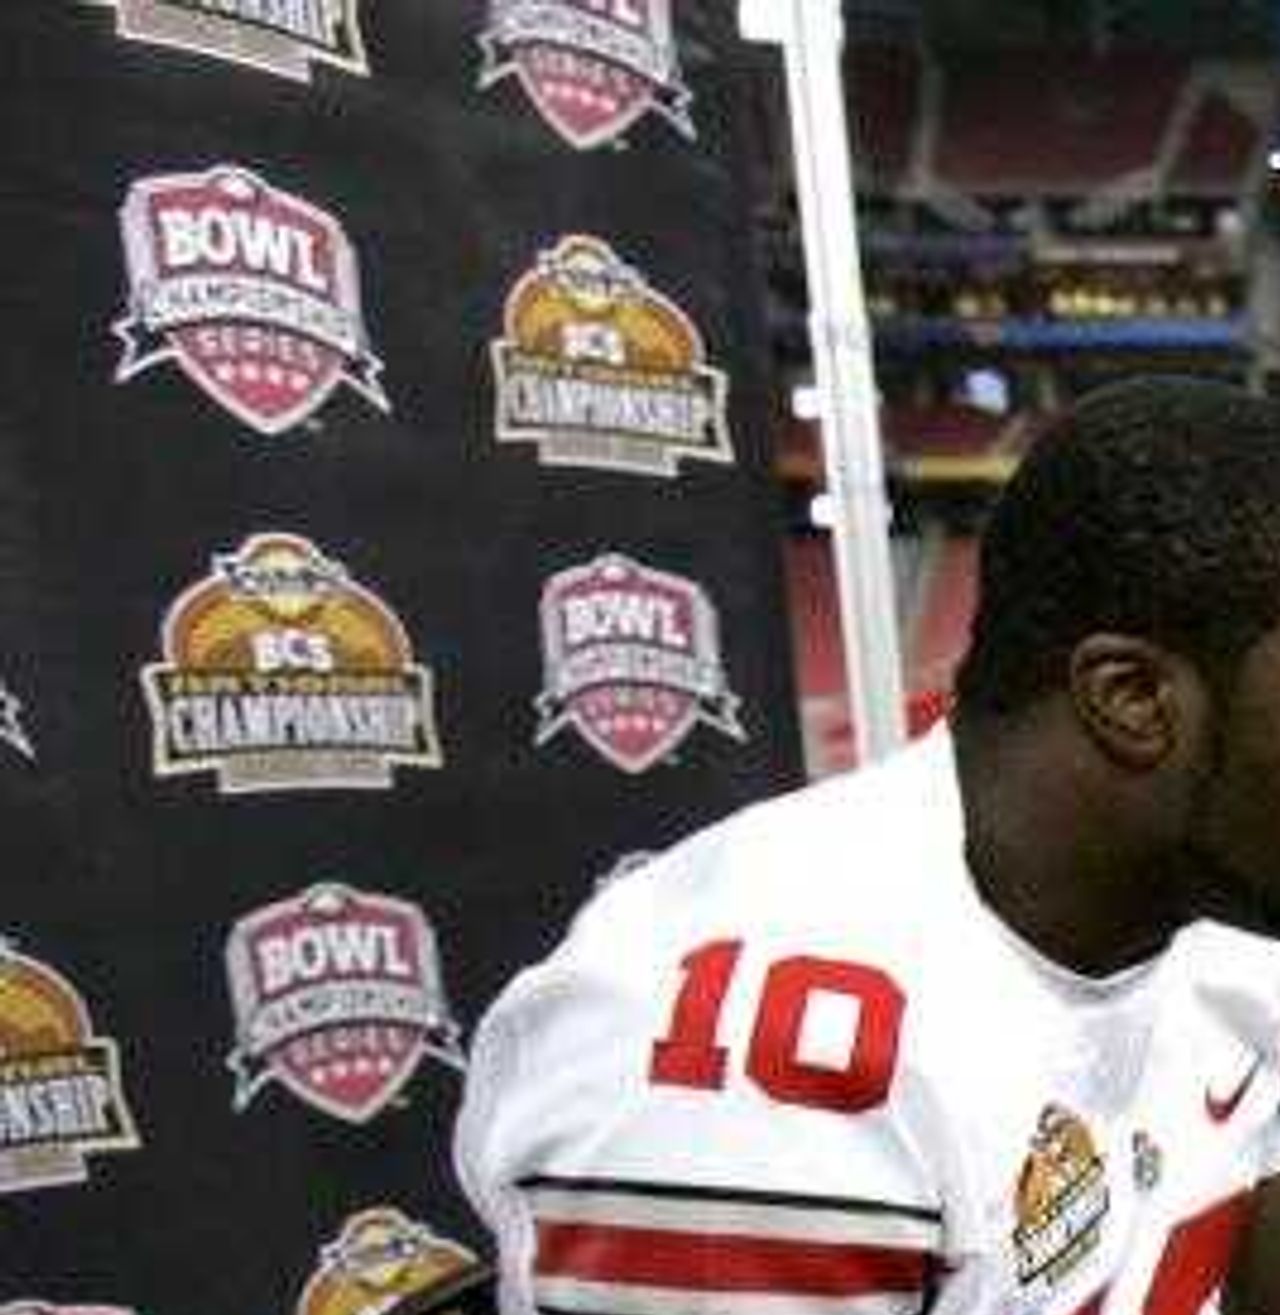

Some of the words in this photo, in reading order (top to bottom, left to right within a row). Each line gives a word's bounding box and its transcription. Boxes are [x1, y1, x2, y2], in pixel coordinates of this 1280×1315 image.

[157, 207, 331, 292] BOWL
[251, 629, 334, 673] BCS
[565, 593, 690, 648] BOWL
[170, 692, 417, 754] CHAMPIONSHIP
[257, 921, 412, 996] BOWL
[648, 936, 908, 1116] 10
